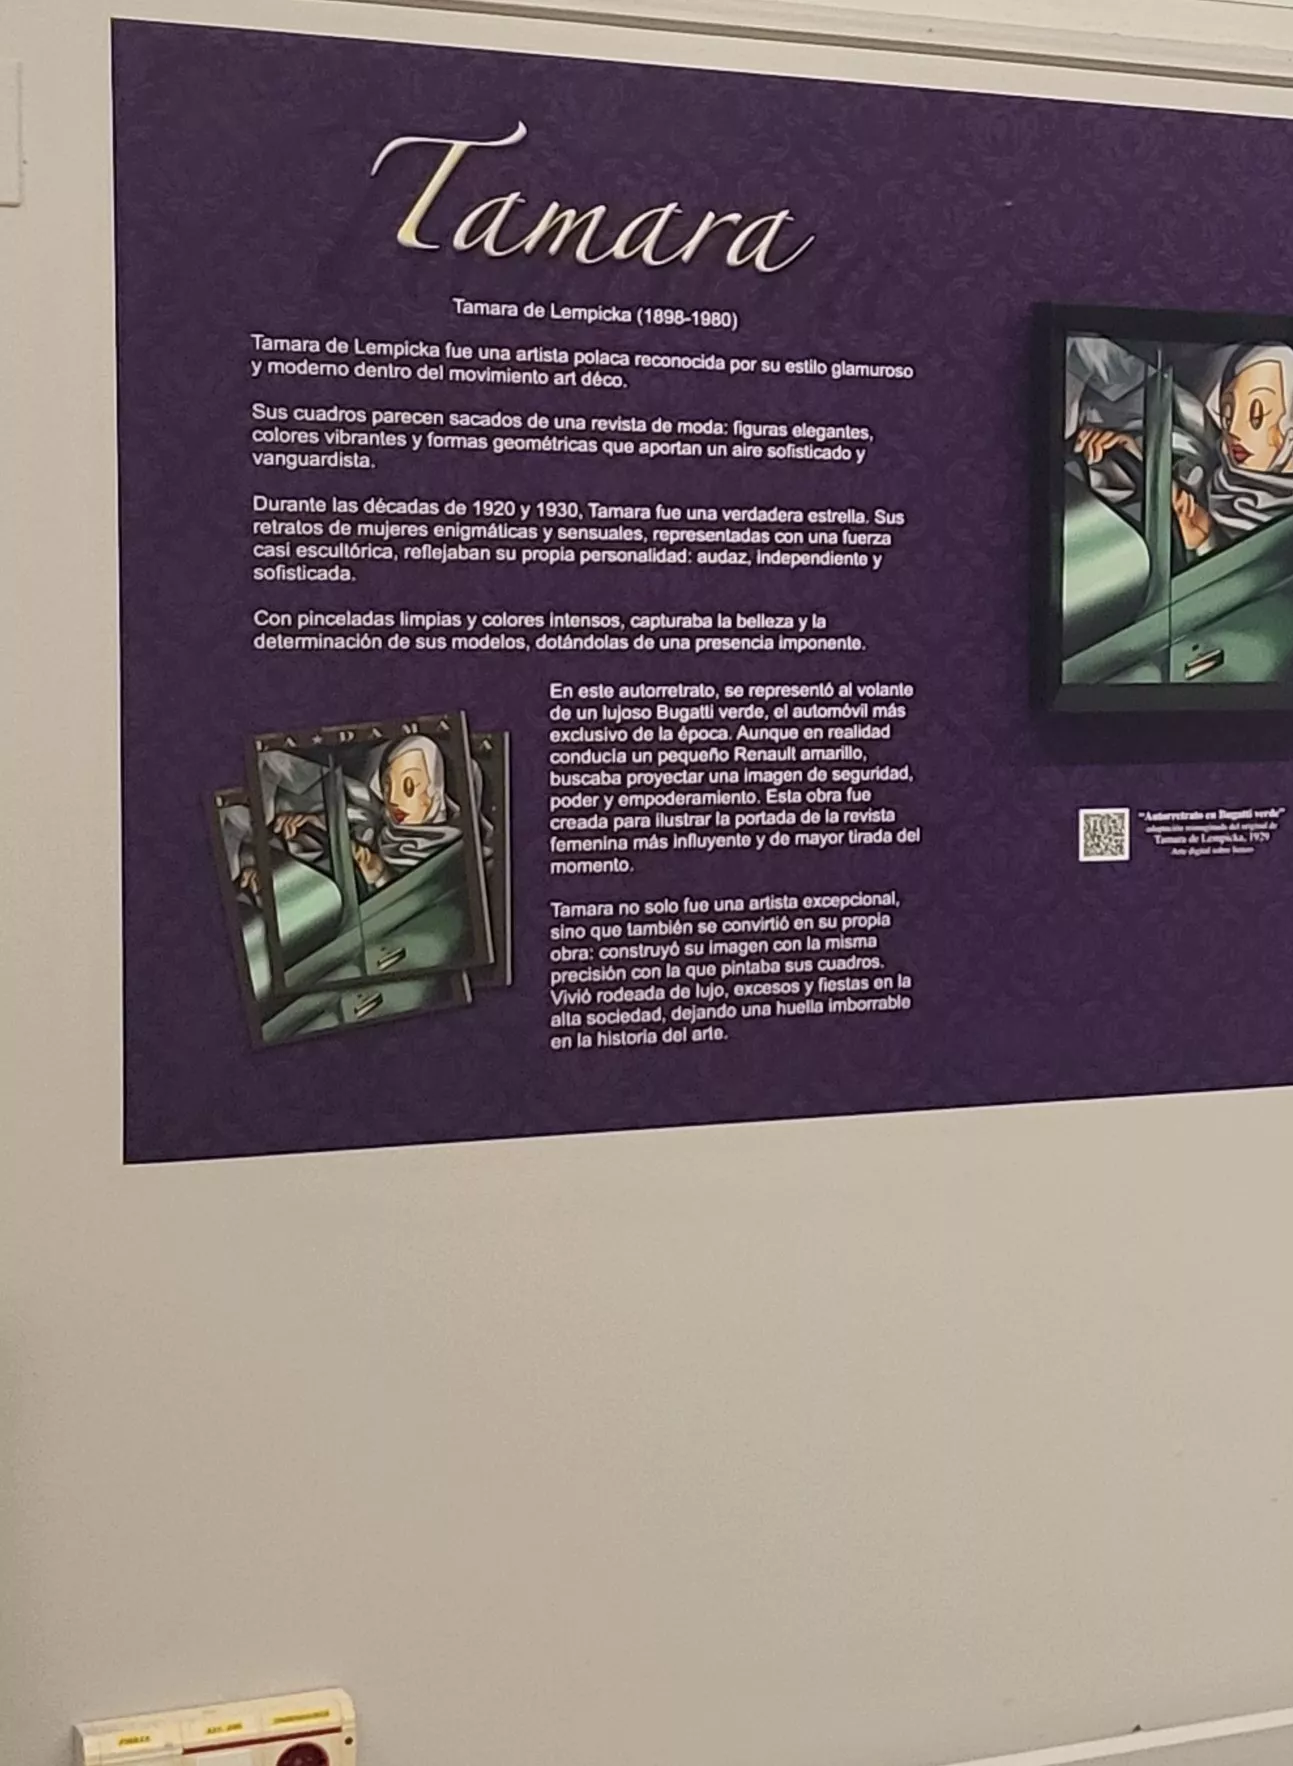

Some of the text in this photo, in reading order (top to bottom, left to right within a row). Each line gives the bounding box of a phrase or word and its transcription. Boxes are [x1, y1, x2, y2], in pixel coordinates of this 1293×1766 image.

[371, 121, 815, 272] Tamara
[452, 297, 737, 331] Tamara de Lempicka (1898-1980)
[250, 333, 913, 379] Tamara de Lempicka fue una artista polaca reconocida por su estilo glamuroso
[251, 358, 626, 387] y moderno dentro del movimiento art déco.
[252, 402, 873, 441] Sus cuadros parecen sacados de una revista de moda: figuras elegantes,
[252, 426, 865, 464] colores vibrantes y formas geométricas que aportan un aire sofisticado y
[252, 451, 375, 470] vanguardista.
[253, 494, 904, 524] Durante las décadas de 1920 y 1930, Tamara fue una verdadera estrella. Sus
[253, 519, 891, 545] retratos de mujeres enigmáticas y sensuales, representadas con una fuerza
[253, 541, 882, 569] casi escultórica, reflejaban su propia personalidad: audaz, independiente y
[253, 564, 355, 581] sofisticada.
[253, 609, 826, 632] Con pinceladas limpias y colores intensos, capturaba la belleza y la
[253, 632, 865, 652] determinación de sus modelos, dotándolas de una presencia imponente.
[550, 681, 913, 700] En este autorretrato, se representó al volante
[549, 702, 906, 723] de un lujoso Bugatti verde, el automóvil más
[549, 723, 890, 744] exclusivo de la época. Aunque en realidad
[550, 765, 912, 788] buscaba proyectar una imagen de seguridad,
[550, 857, 633, 873] momento.
[550, 994, 910, 1027] alta sociedad, dejando una huella imborrable
[550, 1026, 727, 1049] en la historia del arte.
